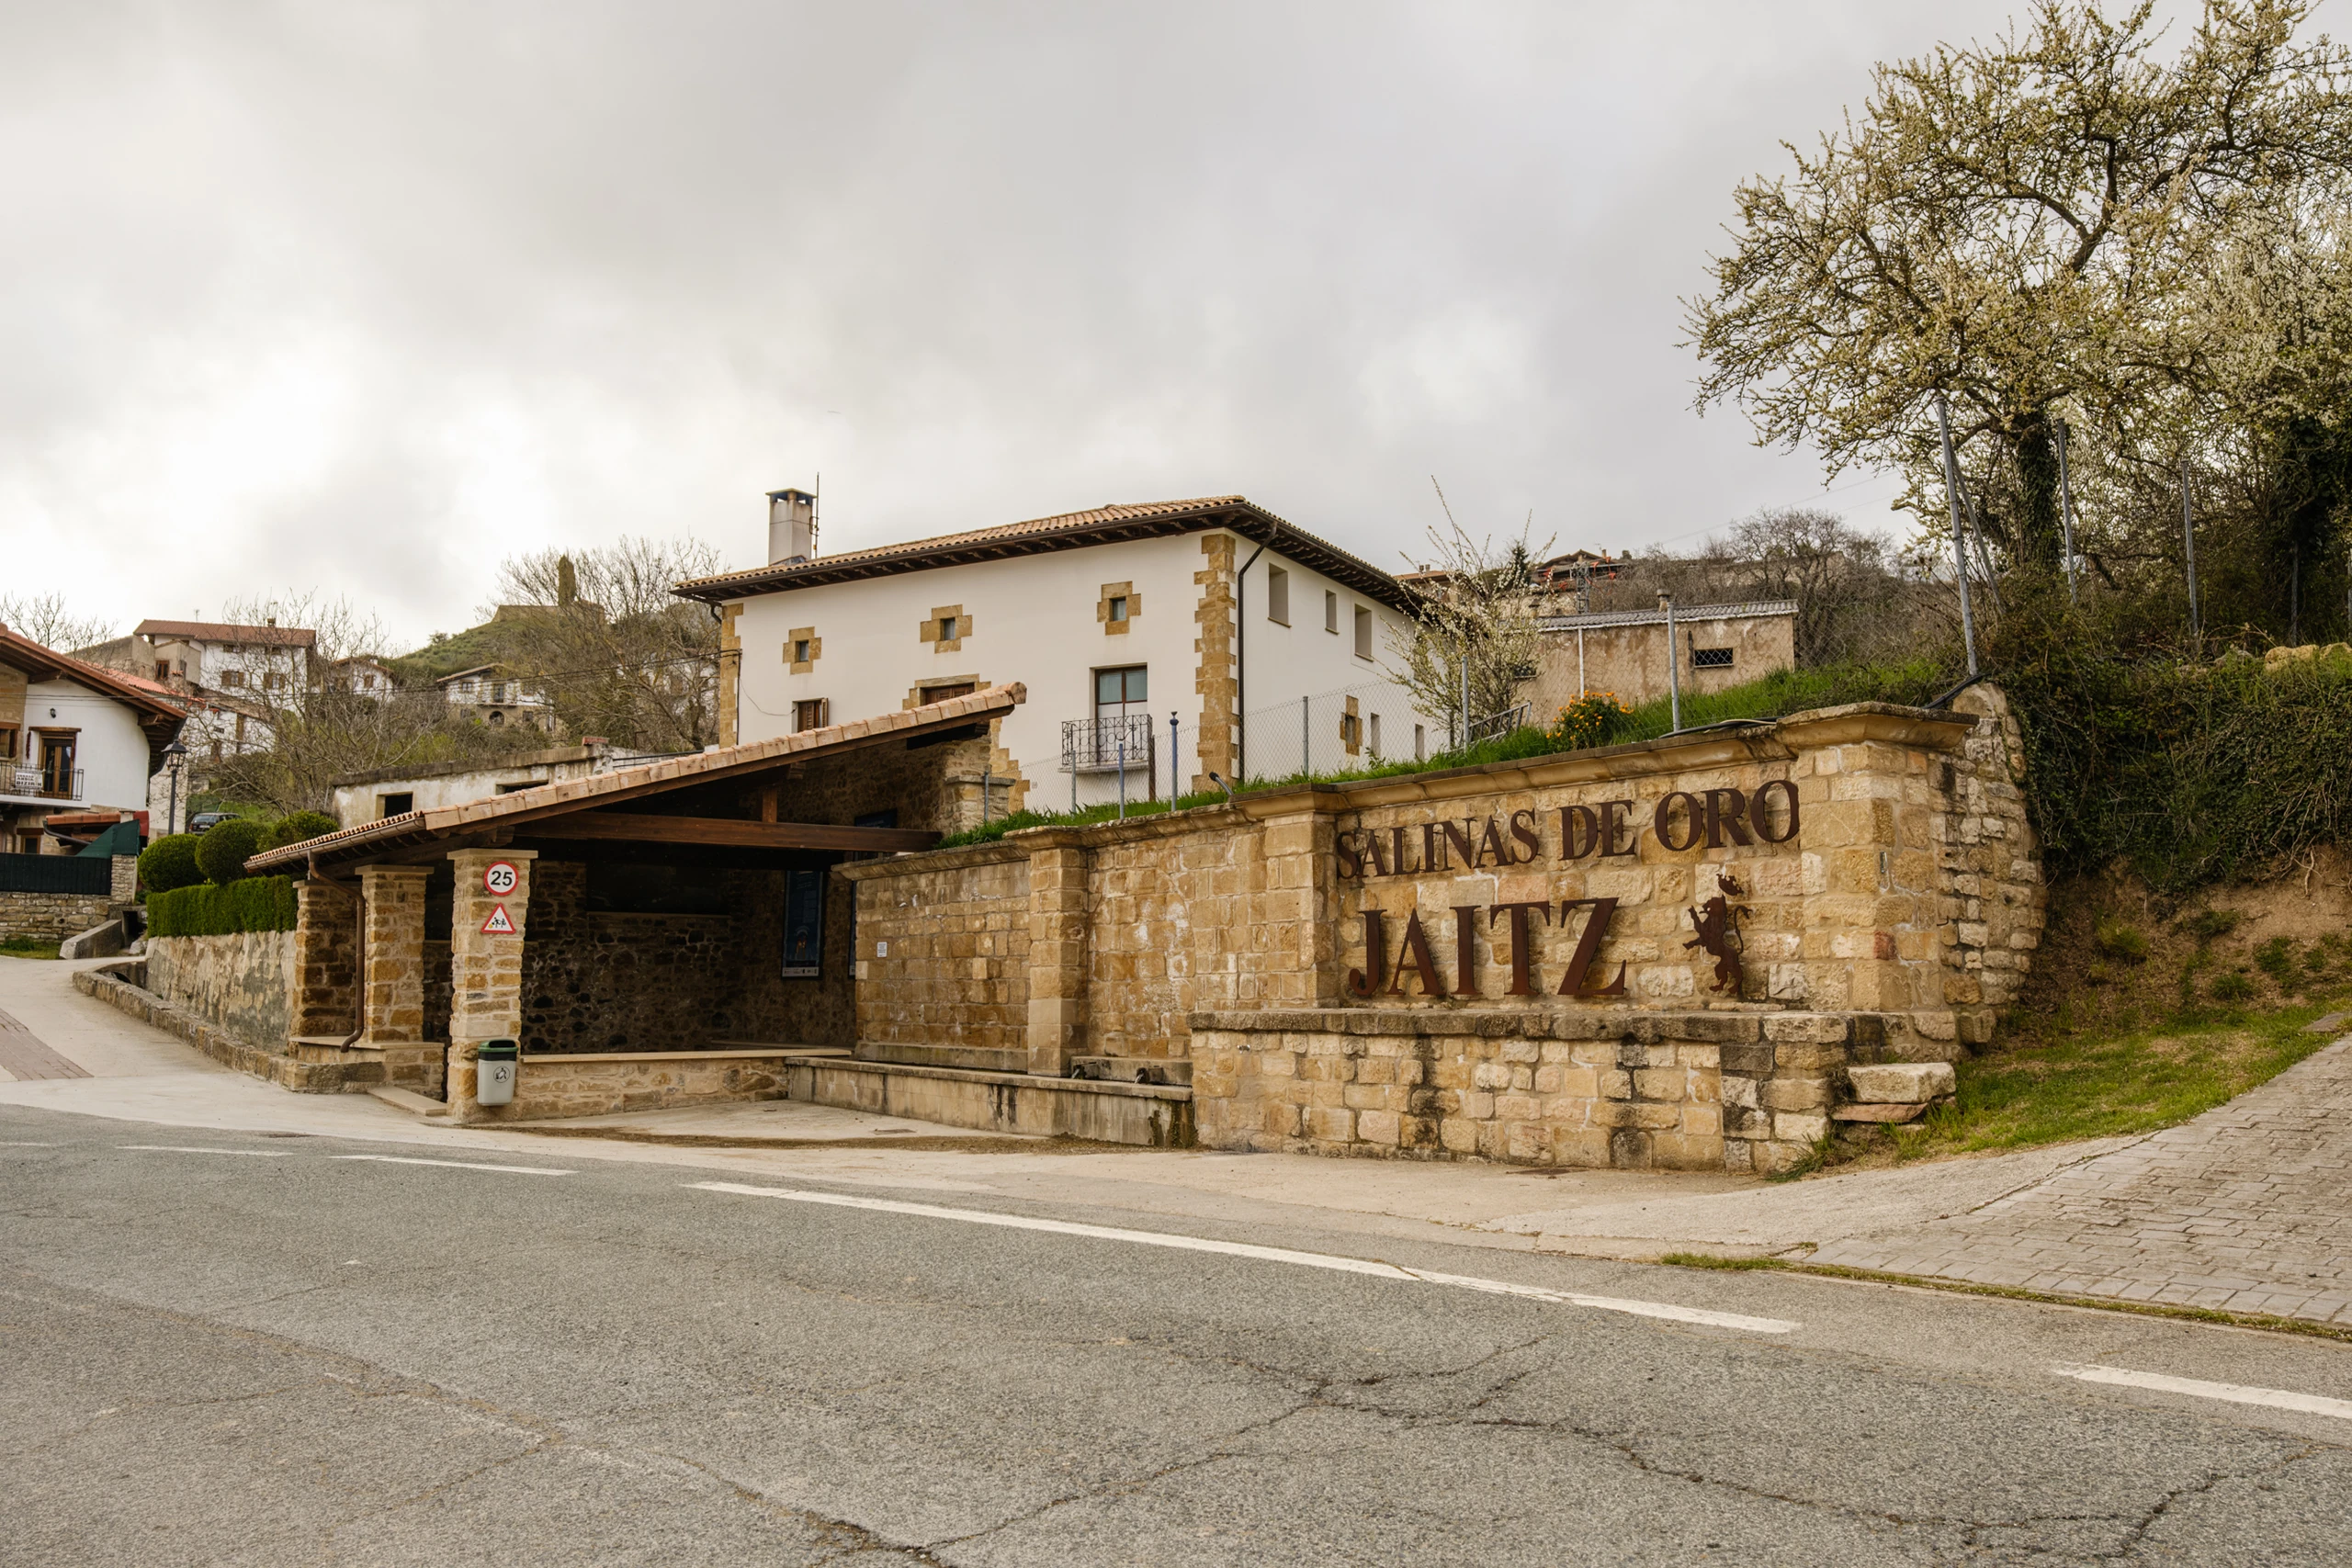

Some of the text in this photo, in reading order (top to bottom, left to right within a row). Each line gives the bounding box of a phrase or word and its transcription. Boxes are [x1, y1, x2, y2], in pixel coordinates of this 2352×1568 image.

[491, 871, 513, 886] 25
[1337, 780, 1800, 880] SALINAS DE ORO
[1349, 897, 1626, 996] JAITZ
